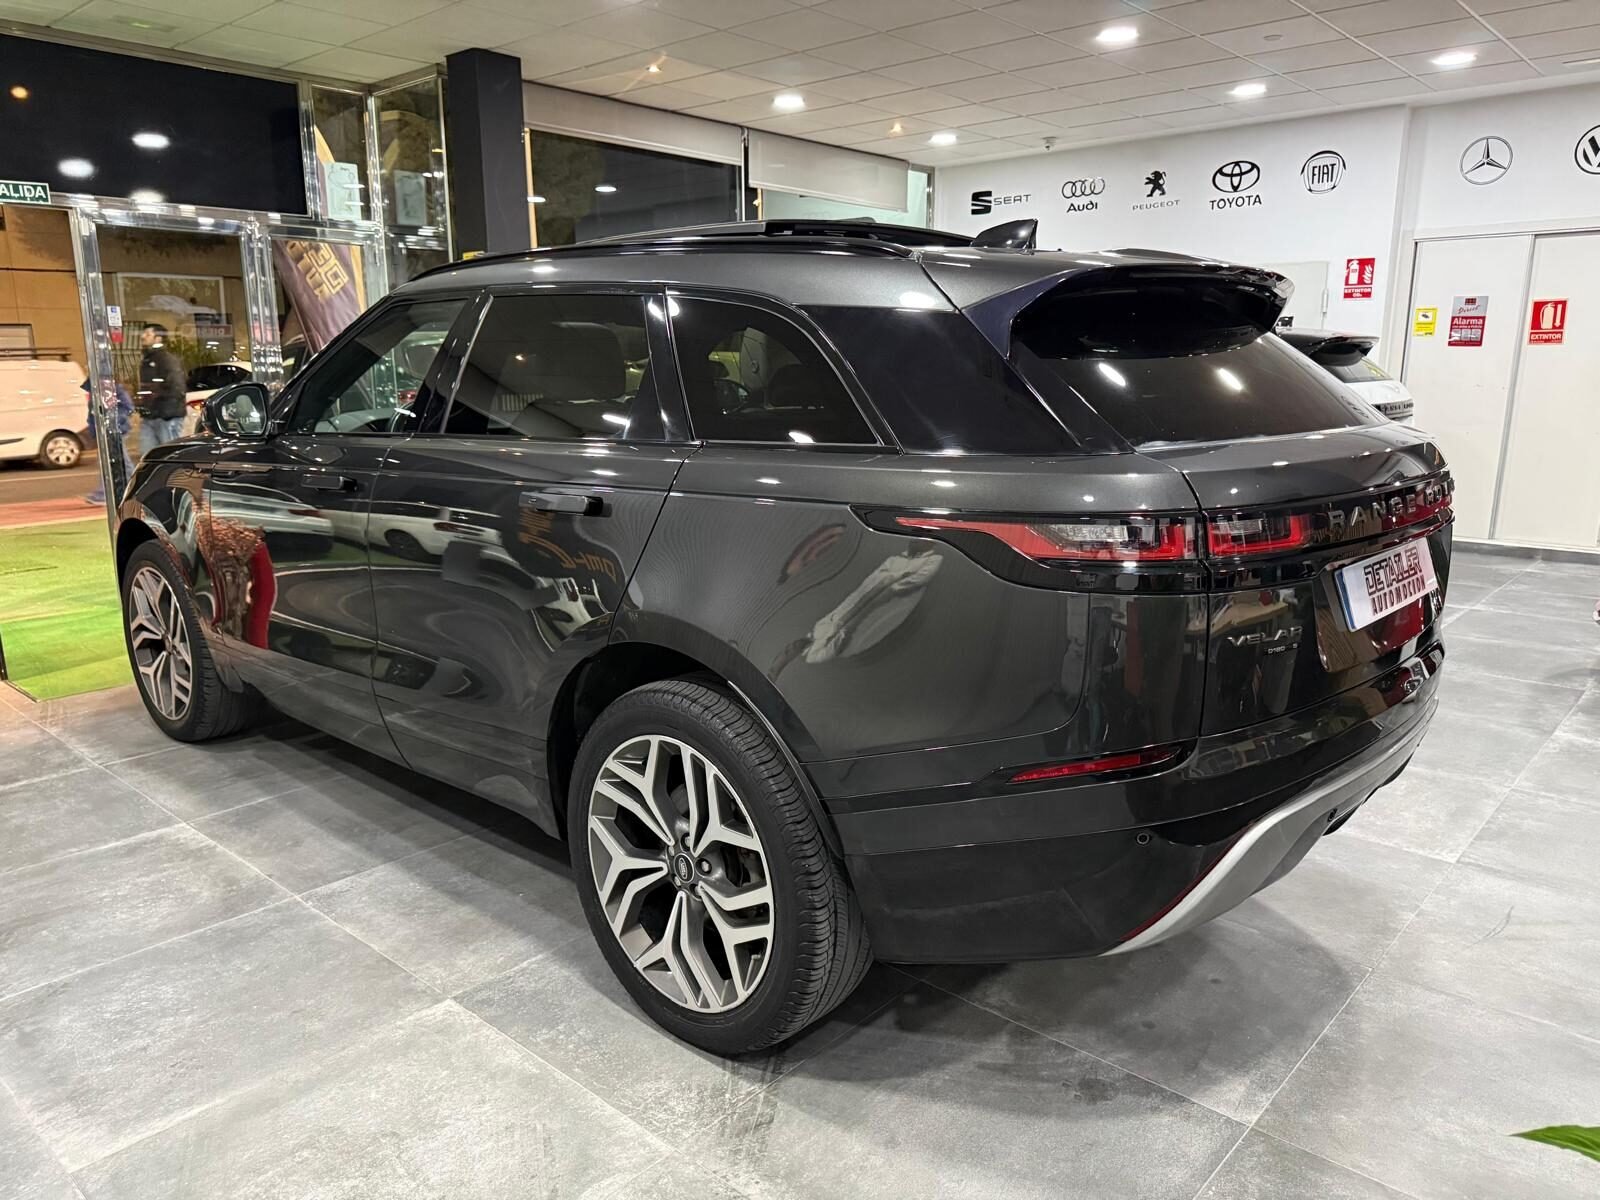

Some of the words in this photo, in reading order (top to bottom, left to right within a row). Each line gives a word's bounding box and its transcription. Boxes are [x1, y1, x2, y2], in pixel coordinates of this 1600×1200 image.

[1311, 163, 1336, 184] FIAT
[0, 184, 46, 198] ALIDA
[994, 194, 1031, 206] SEAT
[1066, 200, 1098, 213] Audi
[1132, 200, 1180, 211] PEUGEOT
[1209, 194, 1262, 210] TOYOTA
[1452, 317, 1483, 325] Alarma
[1530, 333, 1562, 341] EXTINTOR
[1328, 493, 1417, 530] RANGE
[1363, 546, 1423, 596] DETAILER
[1371, 574, 1426, 616] AUTOMOCION
